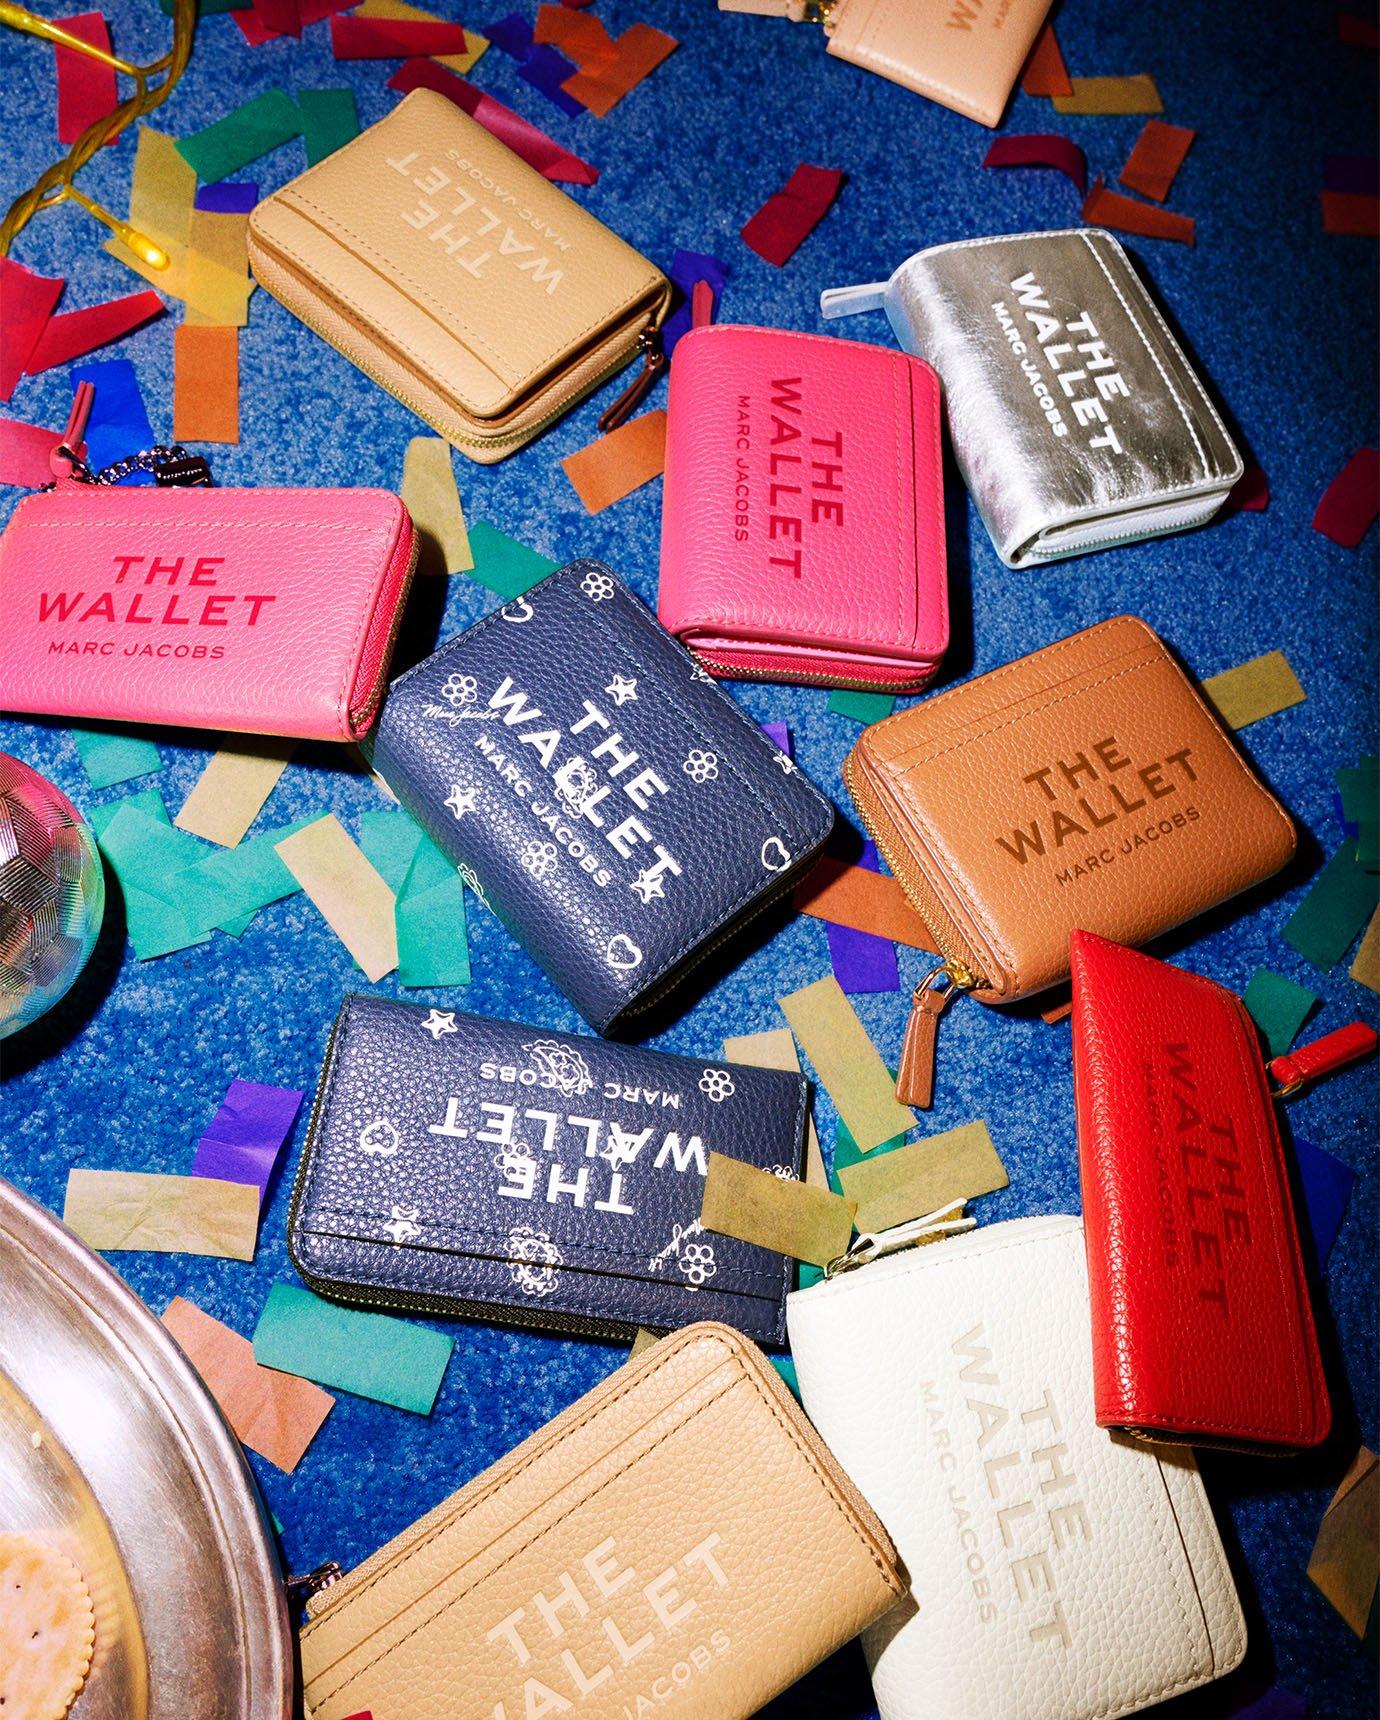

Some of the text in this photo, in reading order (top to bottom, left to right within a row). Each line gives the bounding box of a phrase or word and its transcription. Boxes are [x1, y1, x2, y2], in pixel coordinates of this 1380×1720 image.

[384, 151, 565, 296] WALLET
[400, 199, 492, 280] THE
[445, 149, 571, 253] MARC JACOBS
[991, 301, 1069, 438] MARC JACOBS
[1010, 271, 1123, 455] WALLET
[1065, 311, 1131, 402] THE
[735, 395, 751, 542] MARC JACOBS
[769, 377, 802, 579] WALLET
[811, 431, 844, 527] THE
[38, 592, 277, 627] WALLET
[113, 556, 225, 587] THE
[48, 640, 226, 660] MARC JACOBS
[475, 735, 612, 888] MARC JACOBS
[487, 676, 683, 878] WALLET
[569, 699, 670, 811] THE
[994, 748, 1202, 866] WALLET
[1023, 736, 1133, 802] THE
[1054, 806, 1202, 888] MARC JACOBS
[429, 1098, 708, 1177] WALLET
[603, 1082, 680, 1110] MARC
[498, 1158, 634, 1215] THE
[1143, 1061, 1178, 1269] MARC JACOBS
[1166, 1043, 1230, 1318] WALLET
[1209, 1117, 1252, 1246] THE
[919, 1379, 998, 1625] MARC JACOBS
[951, 1321, 1073, 1650] WALLET
[1021, 1388, 1094, 1550] THE
[486, 1535, 636, 1668] THE
[493, 1531, 734, 1720] ALLET
